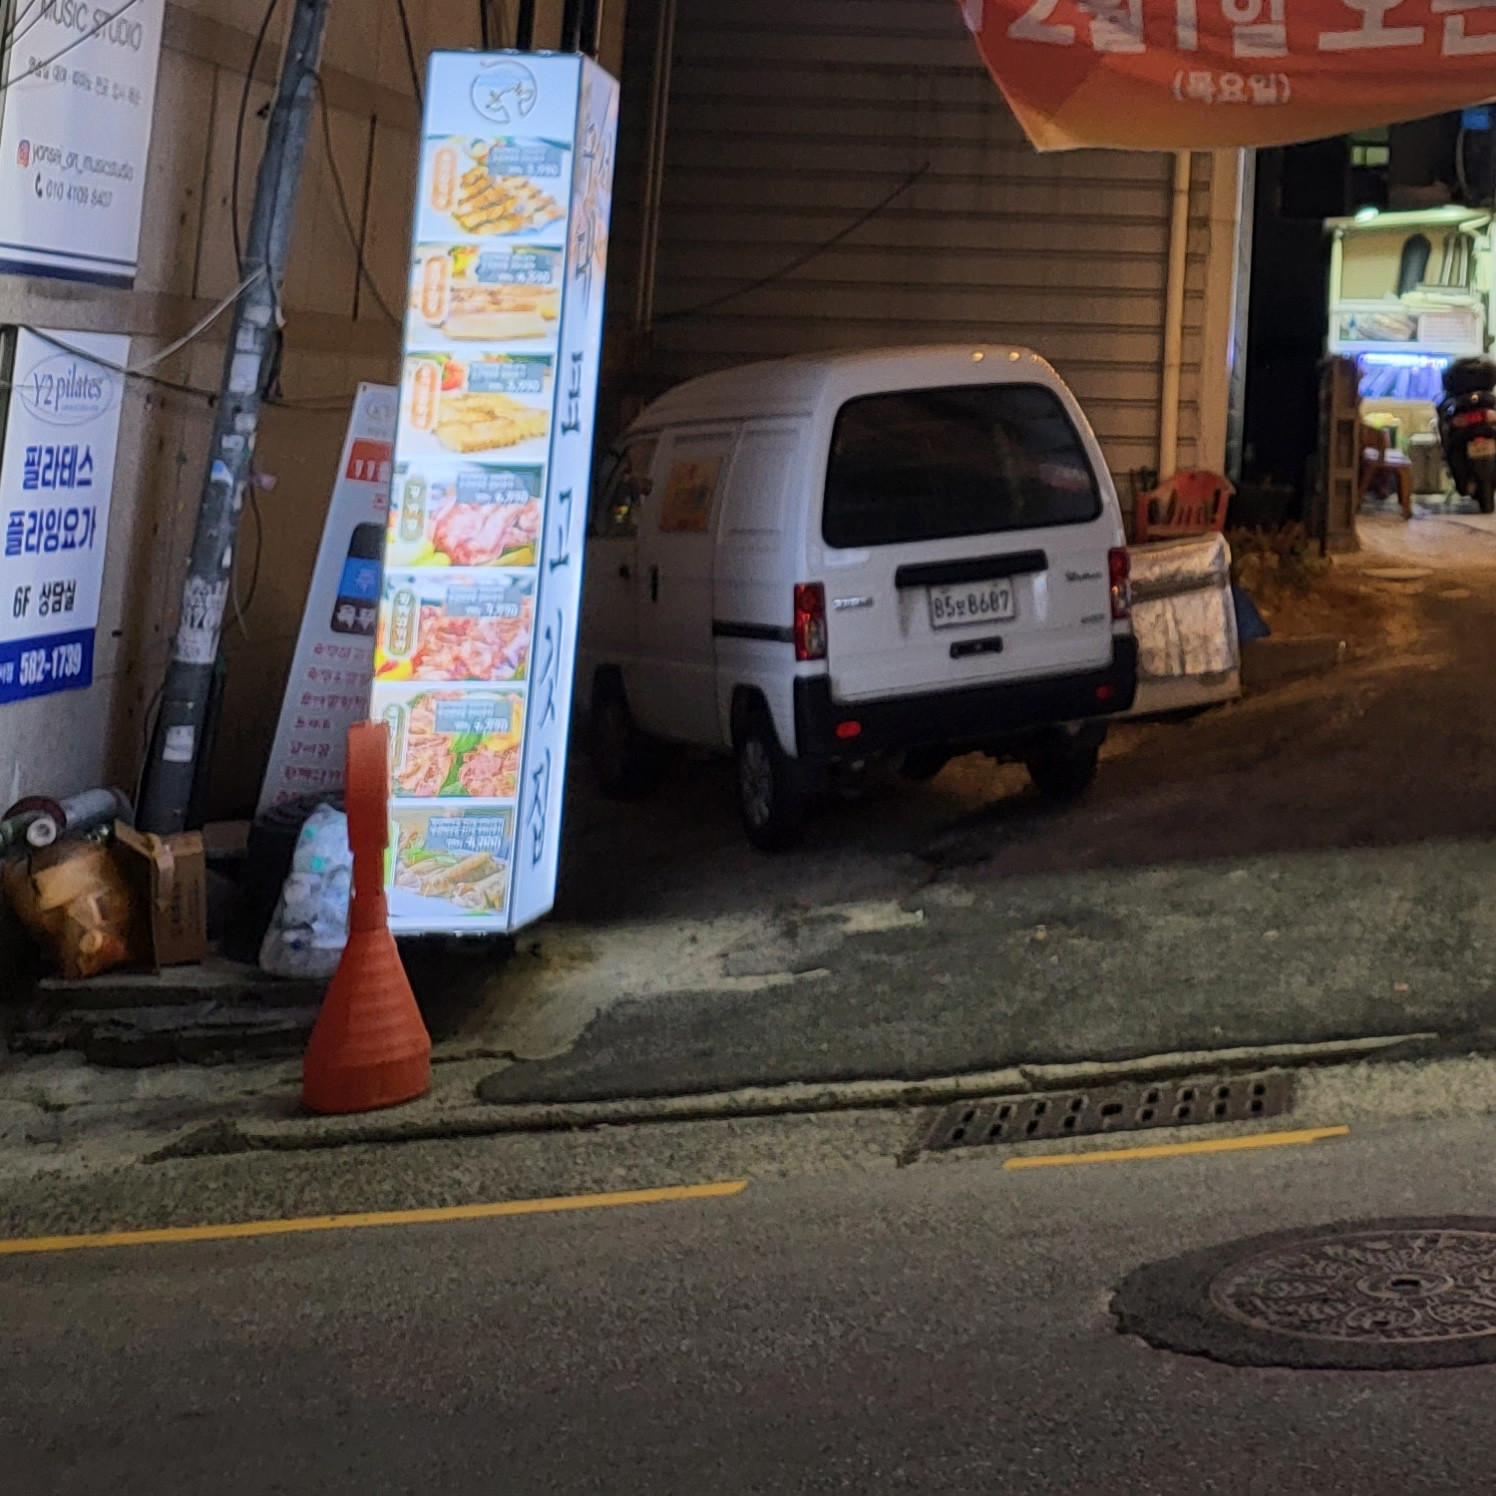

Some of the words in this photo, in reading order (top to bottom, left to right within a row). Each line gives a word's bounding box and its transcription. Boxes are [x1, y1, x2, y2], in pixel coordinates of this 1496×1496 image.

[92, 8, 143, 52] STUDIO
[22, 444, 94, 490] 필라테스
[5, 505, 97, 556] 플라잉요가
[13, 584, 32, 619] 6F
[38, 578, 77, 617] 상담실
